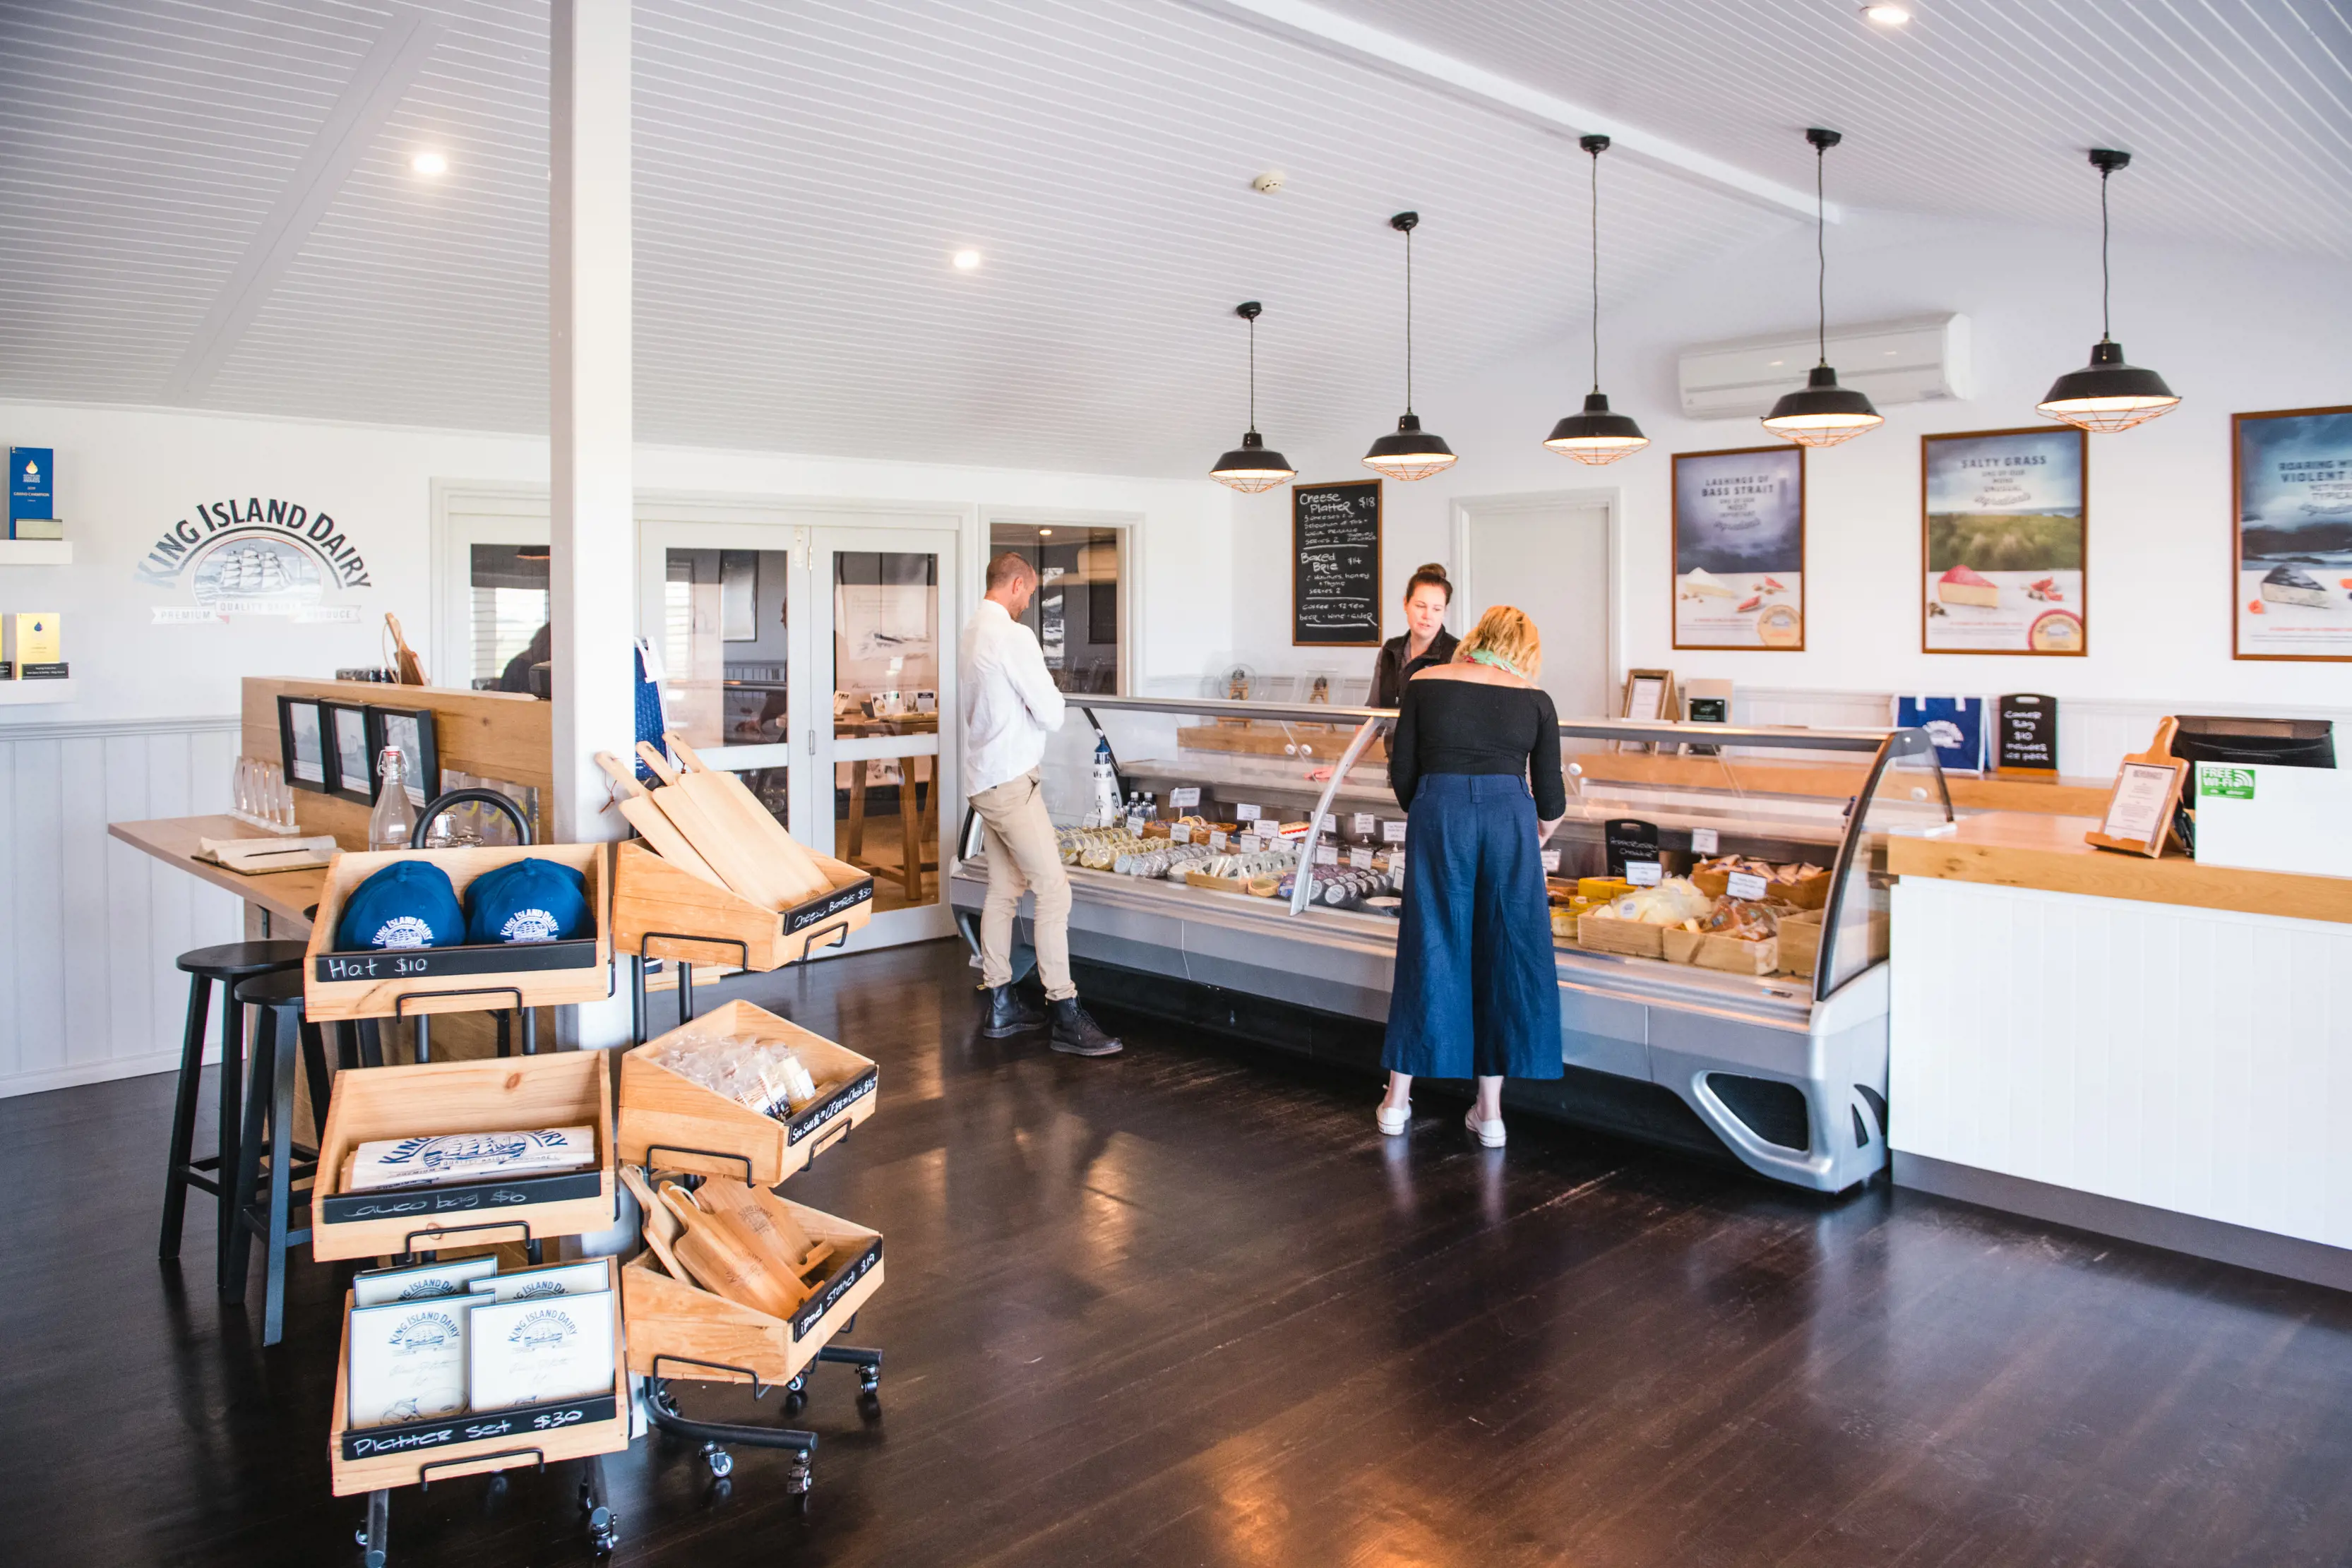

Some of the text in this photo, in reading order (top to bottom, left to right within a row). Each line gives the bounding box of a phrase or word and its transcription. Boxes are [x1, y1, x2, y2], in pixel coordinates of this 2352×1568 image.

[1962, 455, 2047, 469] SALTY GRASS
[2281, 471, 2345, 483] VIOLENT
[1300, 493, 1341, 505] Cheese
[1701, 484, 1774, 497] BASS STRAIT
[1358, 496, 1375, 508] $18
[133, 497, 371, 589] KING ISLAND DAIRY
[220, 602, 262, 611] QUALITY
[160, 611, 211, 620] PREMIUM
[2014, 731, 2033, 741] $10
[2203, 767, 2233, 778] FREE
[794, 907, 826, 928] Cheese
[857, 887, 872, 900] $30
[371, 916, 434, 945] KING ISLAND DAIRY
[500, 909, 560, 936] KING ISLAND DAIRY
[328, 958, 429, 979] Hat $10
[531, 1130, 568, 1147] AIRY
[792, 1127, 803, 1142] Sea
[803, 1119, 814, 1135] Salt
[436, 1194, 479, 1209] bag
[490, 1190, 527, 1203] $6
[410, 1279, 441, 1293] ISLAND
[523, 1280, 554, 1295] ISLAND
[800, 1303, 823, 1335] iPad
[860, 1253, 875, 1274] $19
[388, 1312, 460, 1345] KING ISLAND DAIRY
[508, 1310, 578, 1342] KING ISLAND DAIRY
[465, 1419, 513, 1440] Set
[533, 1410, 584, 1430] $30
